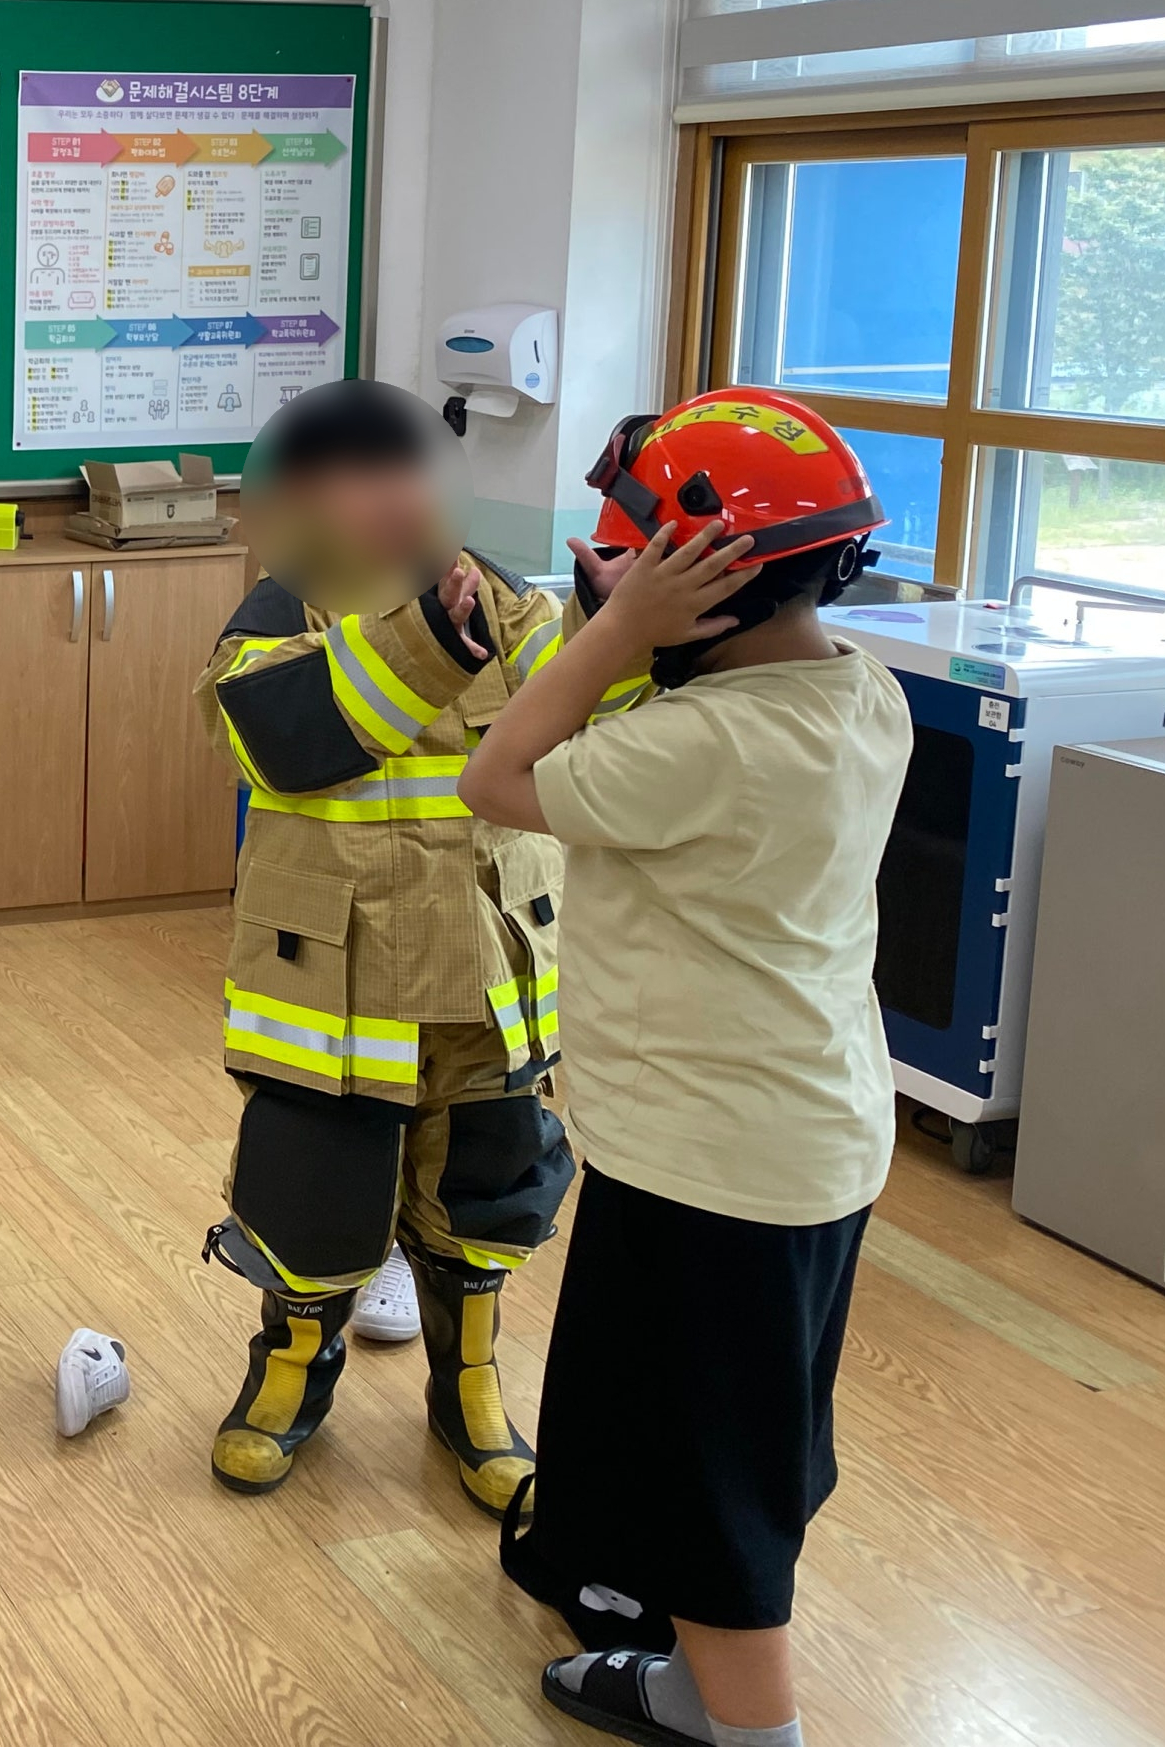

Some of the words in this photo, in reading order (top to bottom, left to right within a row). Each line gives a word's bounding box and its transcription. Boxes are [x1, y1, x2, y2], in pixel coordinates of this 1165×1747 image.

[128, 80, 234, 103] 문제해결시스템
[238, 83, 279, 103] 8단계
[58, 110, 78, 119] 우리는
[80, 110, 93, 119] 모두
[95, 110, 124, 119] 소중하다
[146, 110, 173, 119] 살다보면
[174, 110, 195, 119] 문제가
[221, 112, 235, 120] 있다
[241, 112, 261, 120] 문제를
[291, 112, 319, 120] 성장하자
[51, 137, 71, 146] STEP
[72, 137, 81, 146] 01
[134, 138, 152, 146] STEP
[153, 138, 162, 146] 02
[210, 138, 228, 147] STEP
[285, 138, 303, 146] STEP
[48, 324, 67, 333] STEP
[67, 324, 76, 333] 05
[128, 323, 147, 331] STEP
[207, 321, 224, 330] STEP
[224, 321, 234, 330] 07
[280, 320, 298, 328] STEP
[126, 333, 160, 342] 학부모상담
[197, 330, 242, 341] 생활교육위원회
[271, 328, 316, 338] 학교폭력위원회
